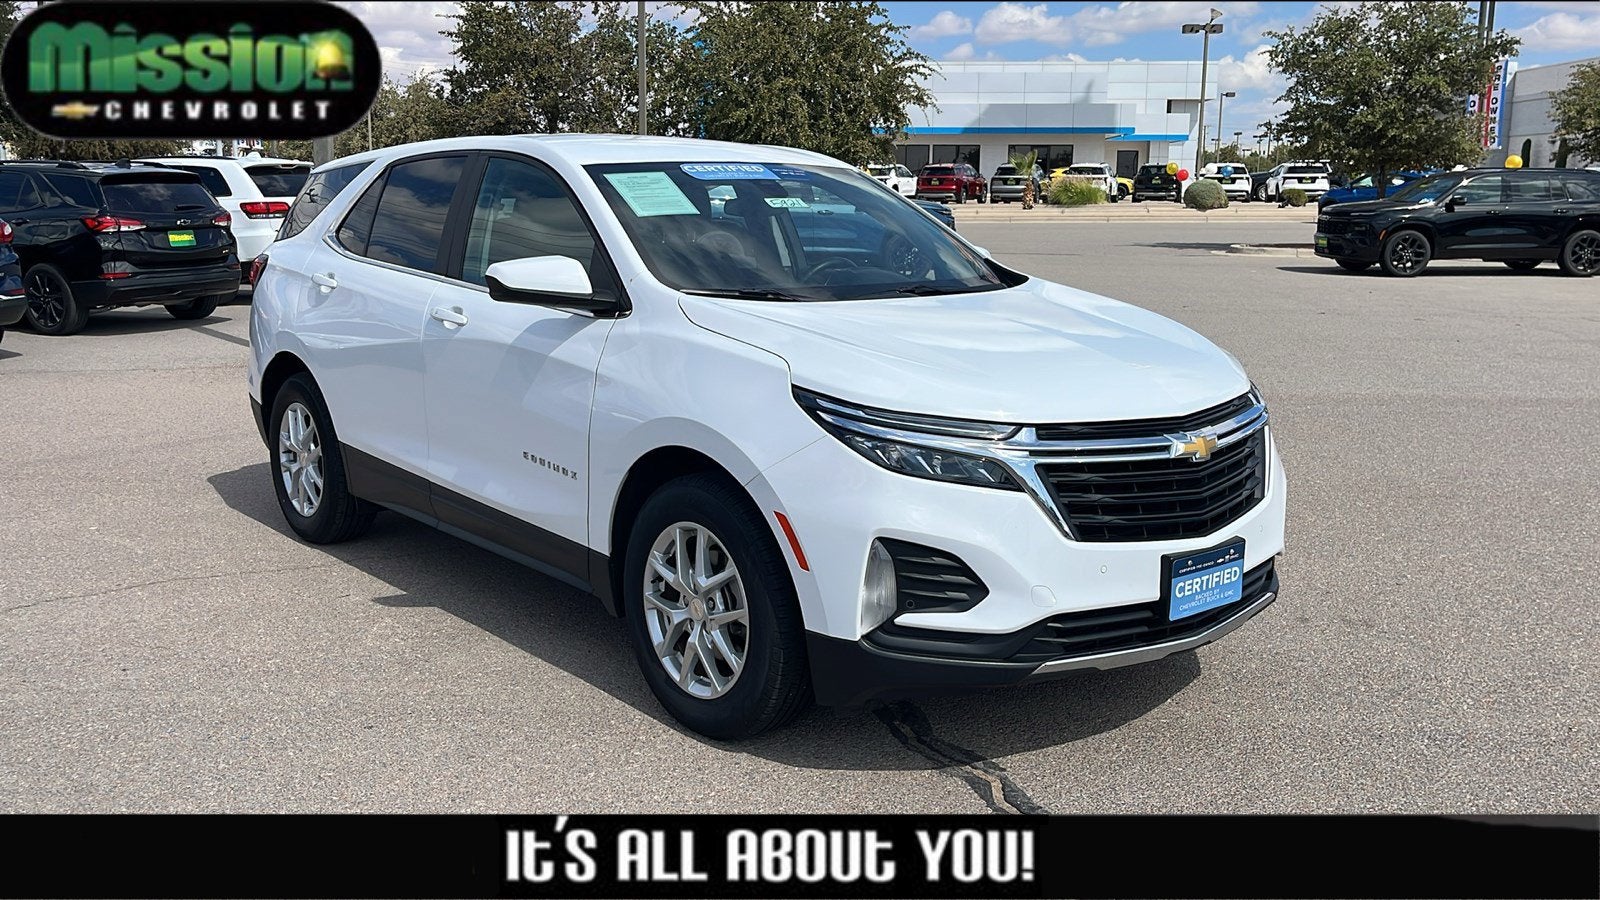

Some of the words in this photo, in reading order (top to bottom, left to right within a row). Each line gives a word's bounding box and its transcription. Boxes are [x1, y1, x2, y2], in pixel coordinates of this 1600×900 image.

[683, 164, 764, 173] CERTIFIED
[522, 450, 578, 480] EQUINOX
[1175, 566, 1240, 598] CERTIFIED
